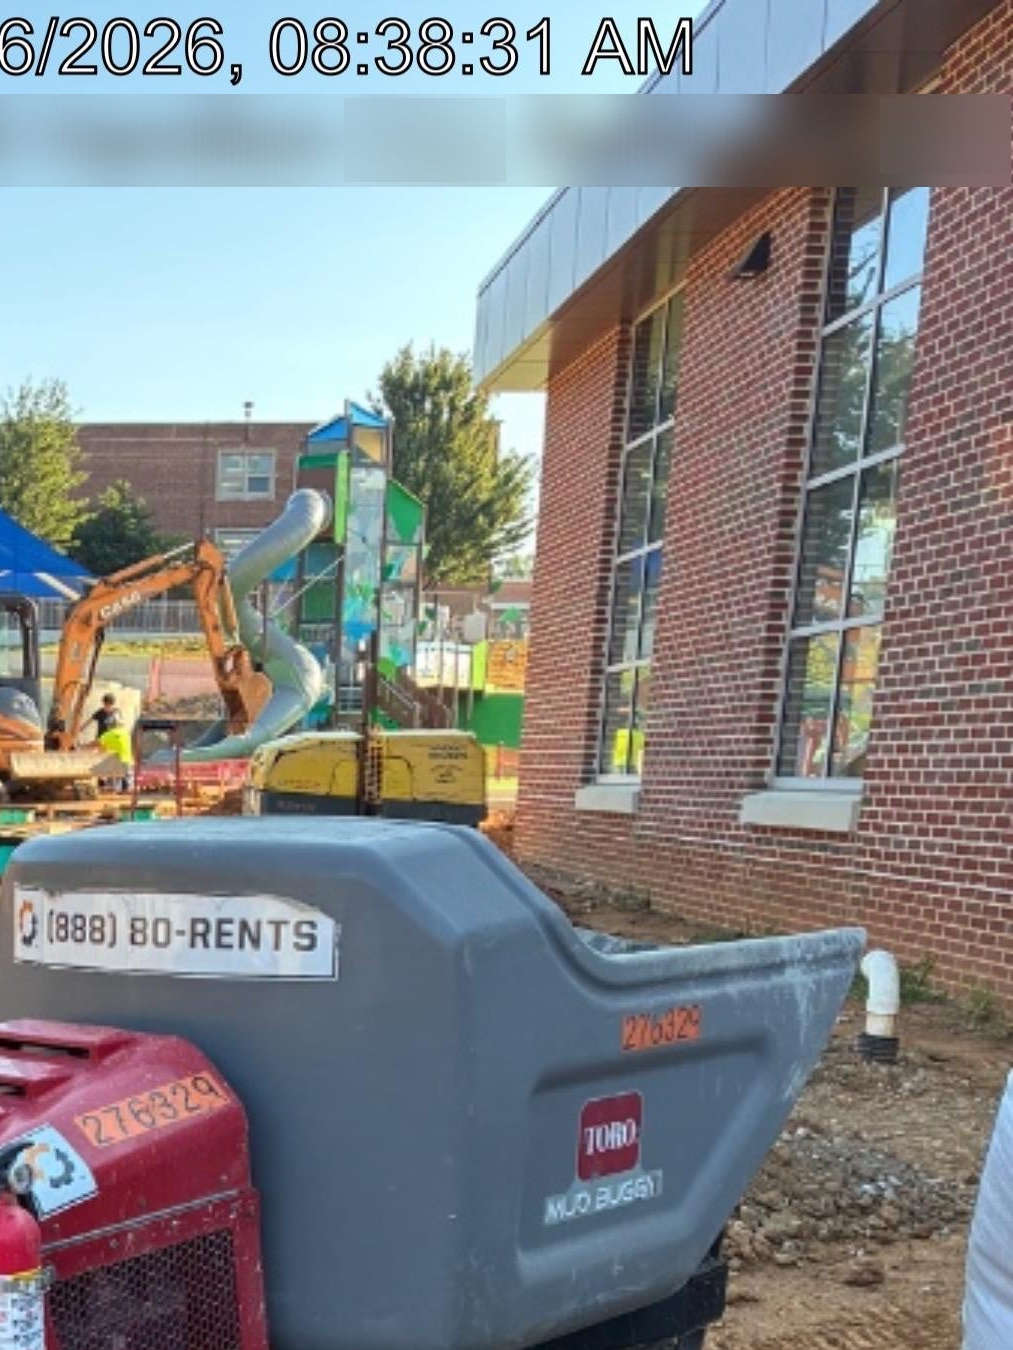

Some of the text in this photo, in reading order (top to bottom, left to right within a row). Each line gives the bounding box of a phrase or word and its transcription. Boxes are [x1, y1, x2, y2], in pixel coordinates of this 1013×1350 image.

[46, 908, 117, 948] (888)
[81, 1075, 227, 1145] 276329
[584, 1118, 637, 1155] TORO
[595, 1174, 659, 1211] BUGGY
